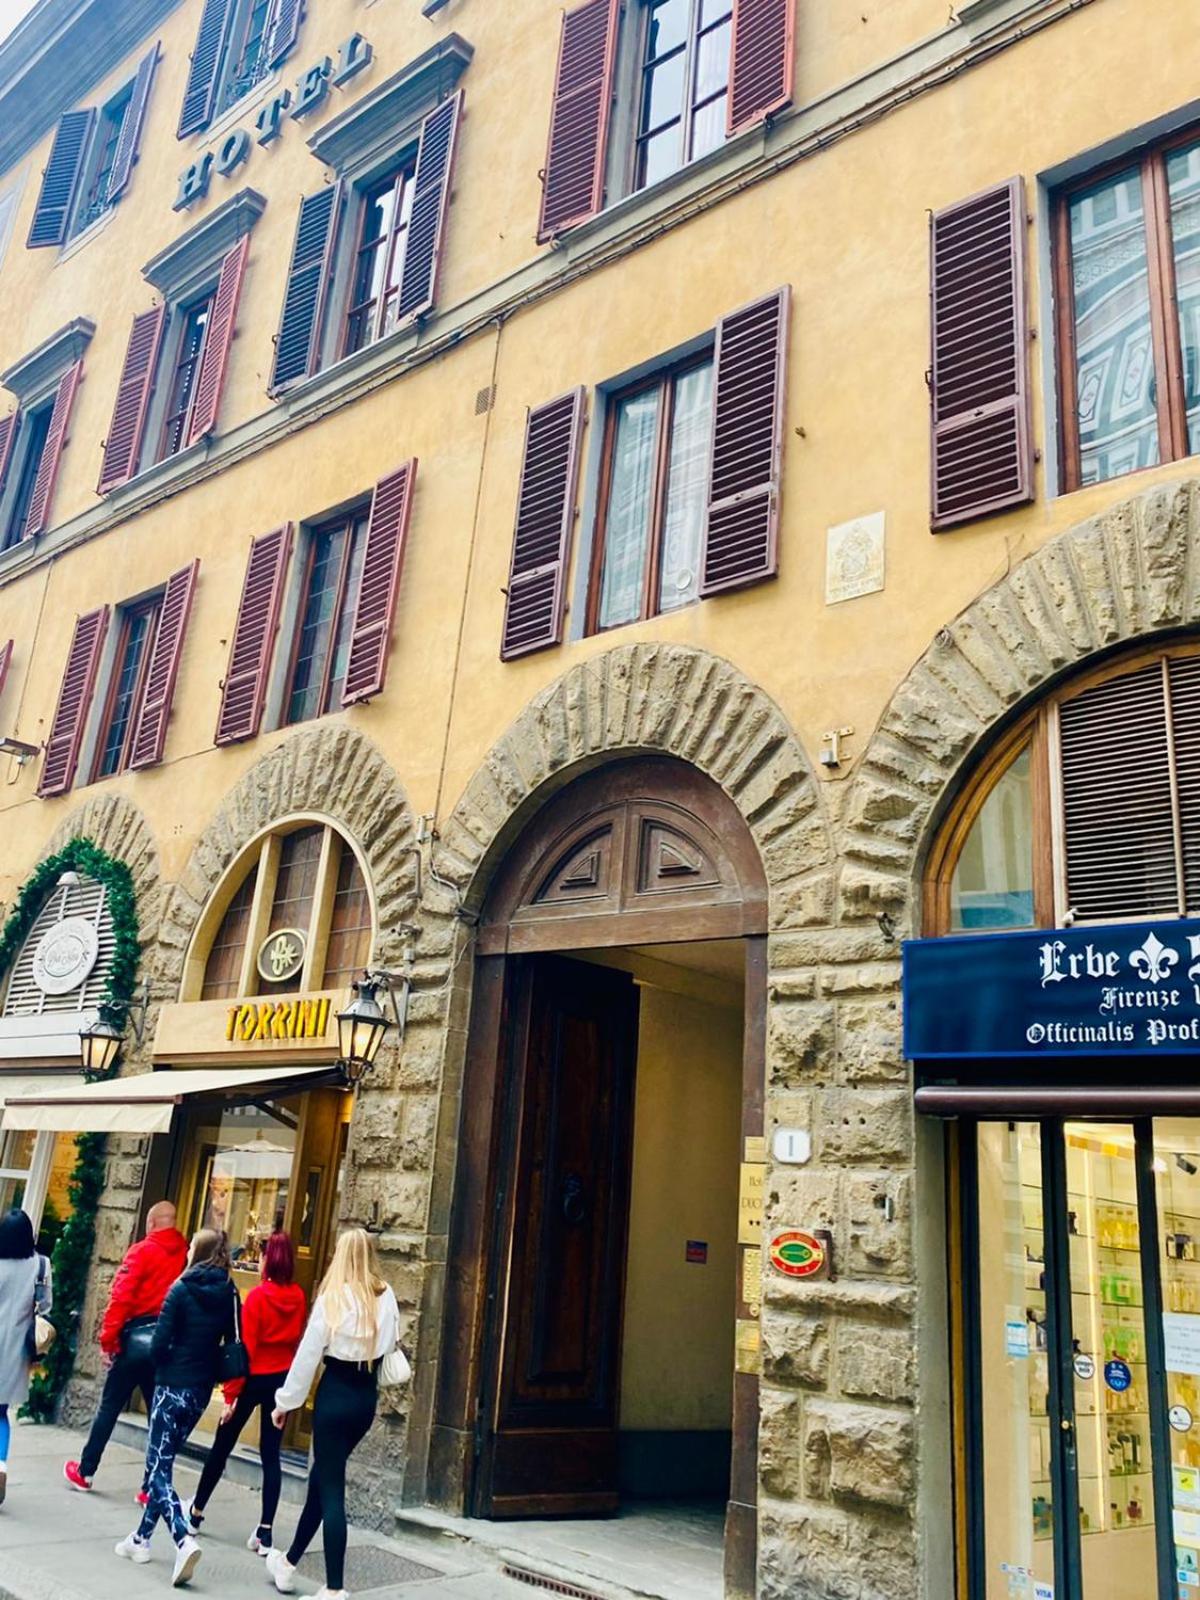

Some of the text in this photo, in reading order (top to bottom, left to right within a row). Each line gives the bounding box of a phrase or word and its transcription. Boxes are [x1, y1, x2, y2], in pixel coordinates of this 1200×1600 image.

[172, 32, 374, 212] HOTEL
[1038, 940, 1120, 989] Erbe
[1099, 986, 1180, 1015] Firenze
[225, 998, 332, 1041] TORRINI
[1026, 1020, 1134, 1044] Officinalis
[1034, 1588, 1053, 1598] VISA
